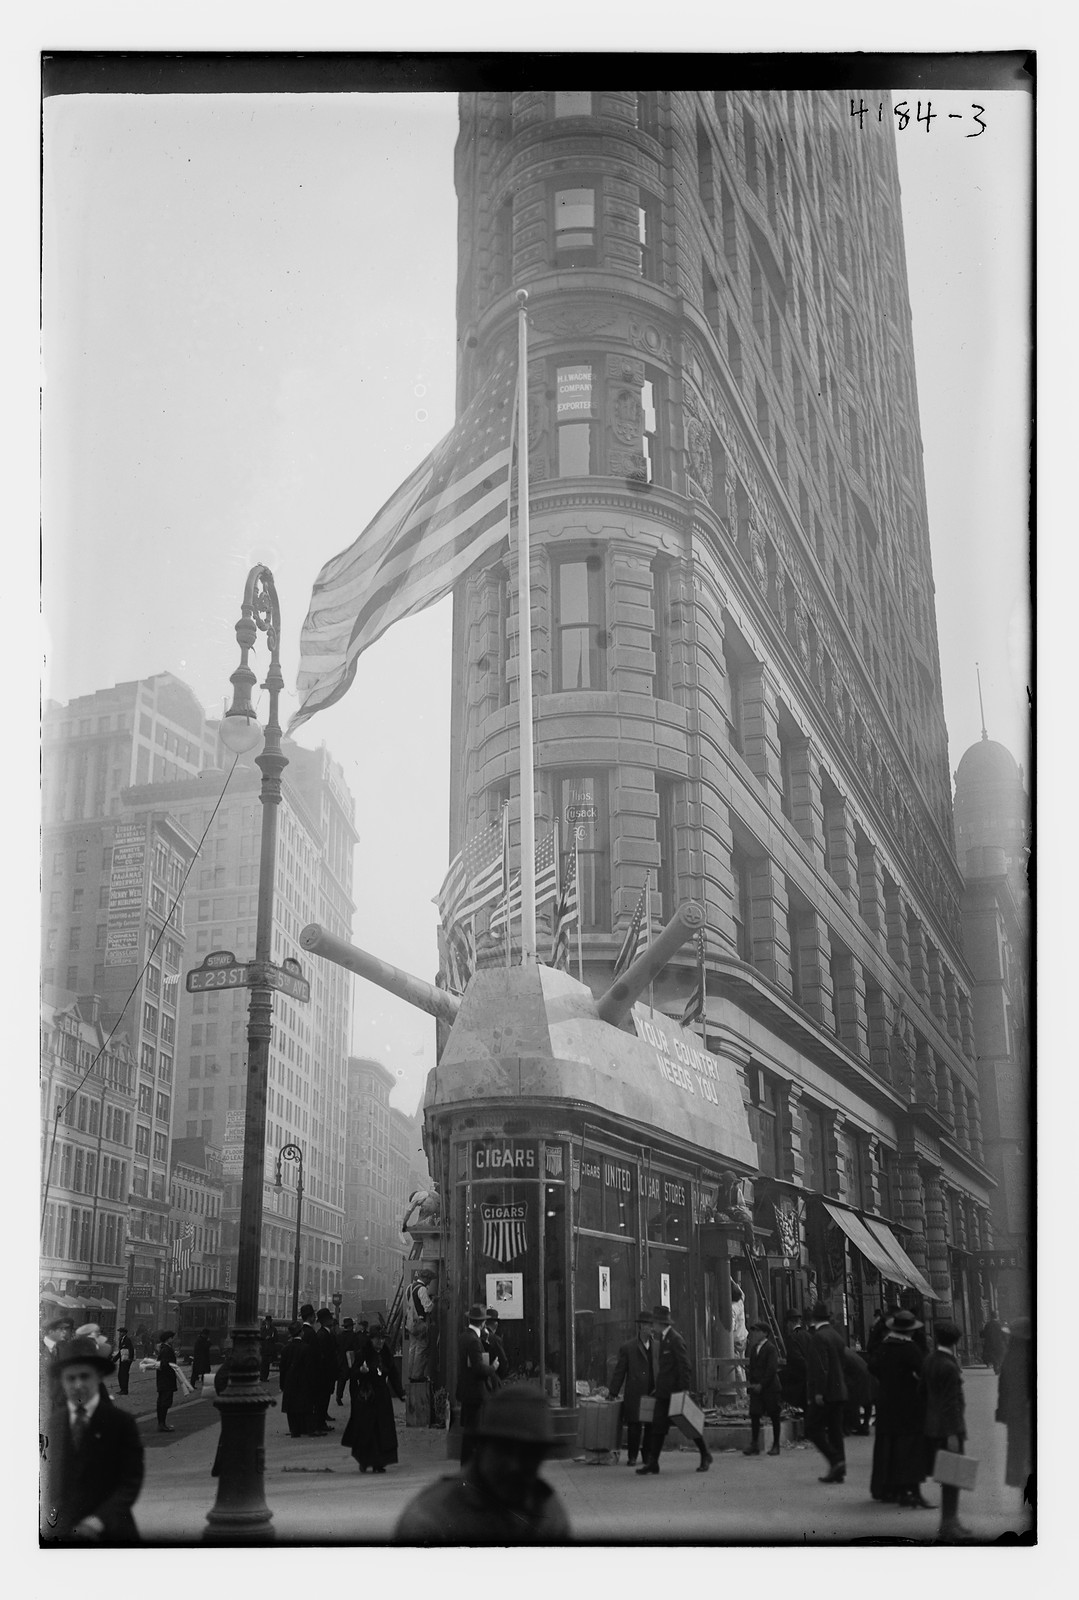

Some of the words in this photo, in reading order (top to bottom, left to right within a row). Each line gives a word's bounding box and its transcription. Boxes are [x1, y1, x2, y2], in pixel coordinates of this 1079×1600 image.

[112, 878, 142, 887] UNDERWEAR
[113, 871, 142, 880] PAJAMAS
[190, 974, 201, 988] E.
[205, 970, 226, 987] 23
[229, 968, 247, 984] ST.
[292, 981, 307, 998] AVE
[634, 1016, 670, 1055] YOUR
[673, 1038, 720, 1082] COUNTRY
[656, 1053, 694, 1095] NEEDS
[695, 1074, 718, 1106] YOU
[476, 1149, 534, 1168] CIGARS
[581, 1162, 600, 1179] CIGARS
[604, 1164, 631, 1192] UNITED
[640, 1174, 660, 1200] CIGAR
[664, 1181, 686, 1206] STORES
[484, 1207, 524, 1218] CIGARS
